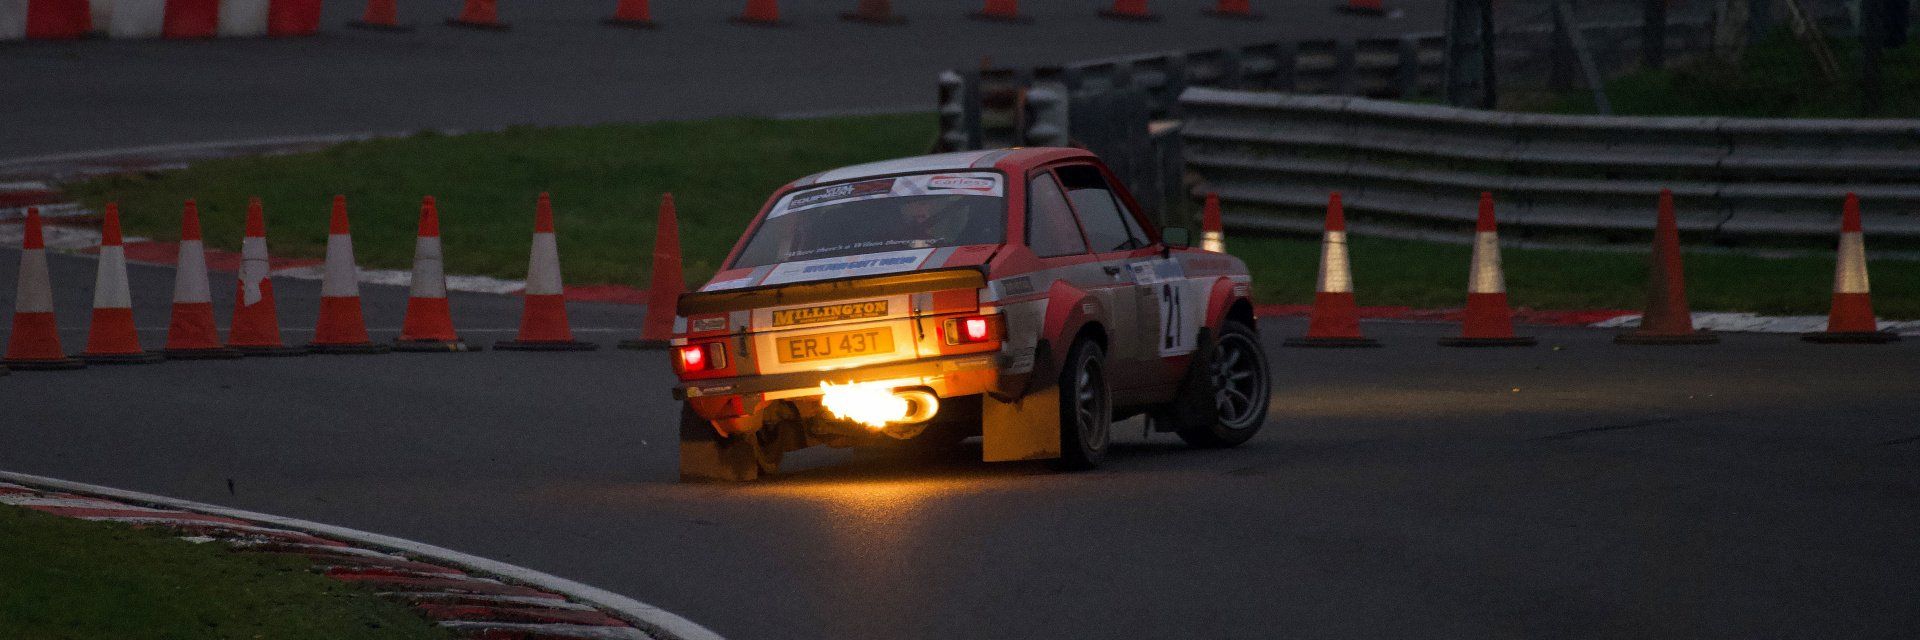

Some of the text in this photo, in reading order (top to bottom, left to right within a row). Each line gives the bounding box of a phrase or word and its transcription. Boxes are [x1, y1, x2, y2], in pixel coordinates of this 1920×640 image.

[934, 178, 988, 187] carless
[775, 301, 887, 325] MILLINGTON
[1163, 284, 1182, 350] 21
[789, 331, 879, 359] ERJ 43T
